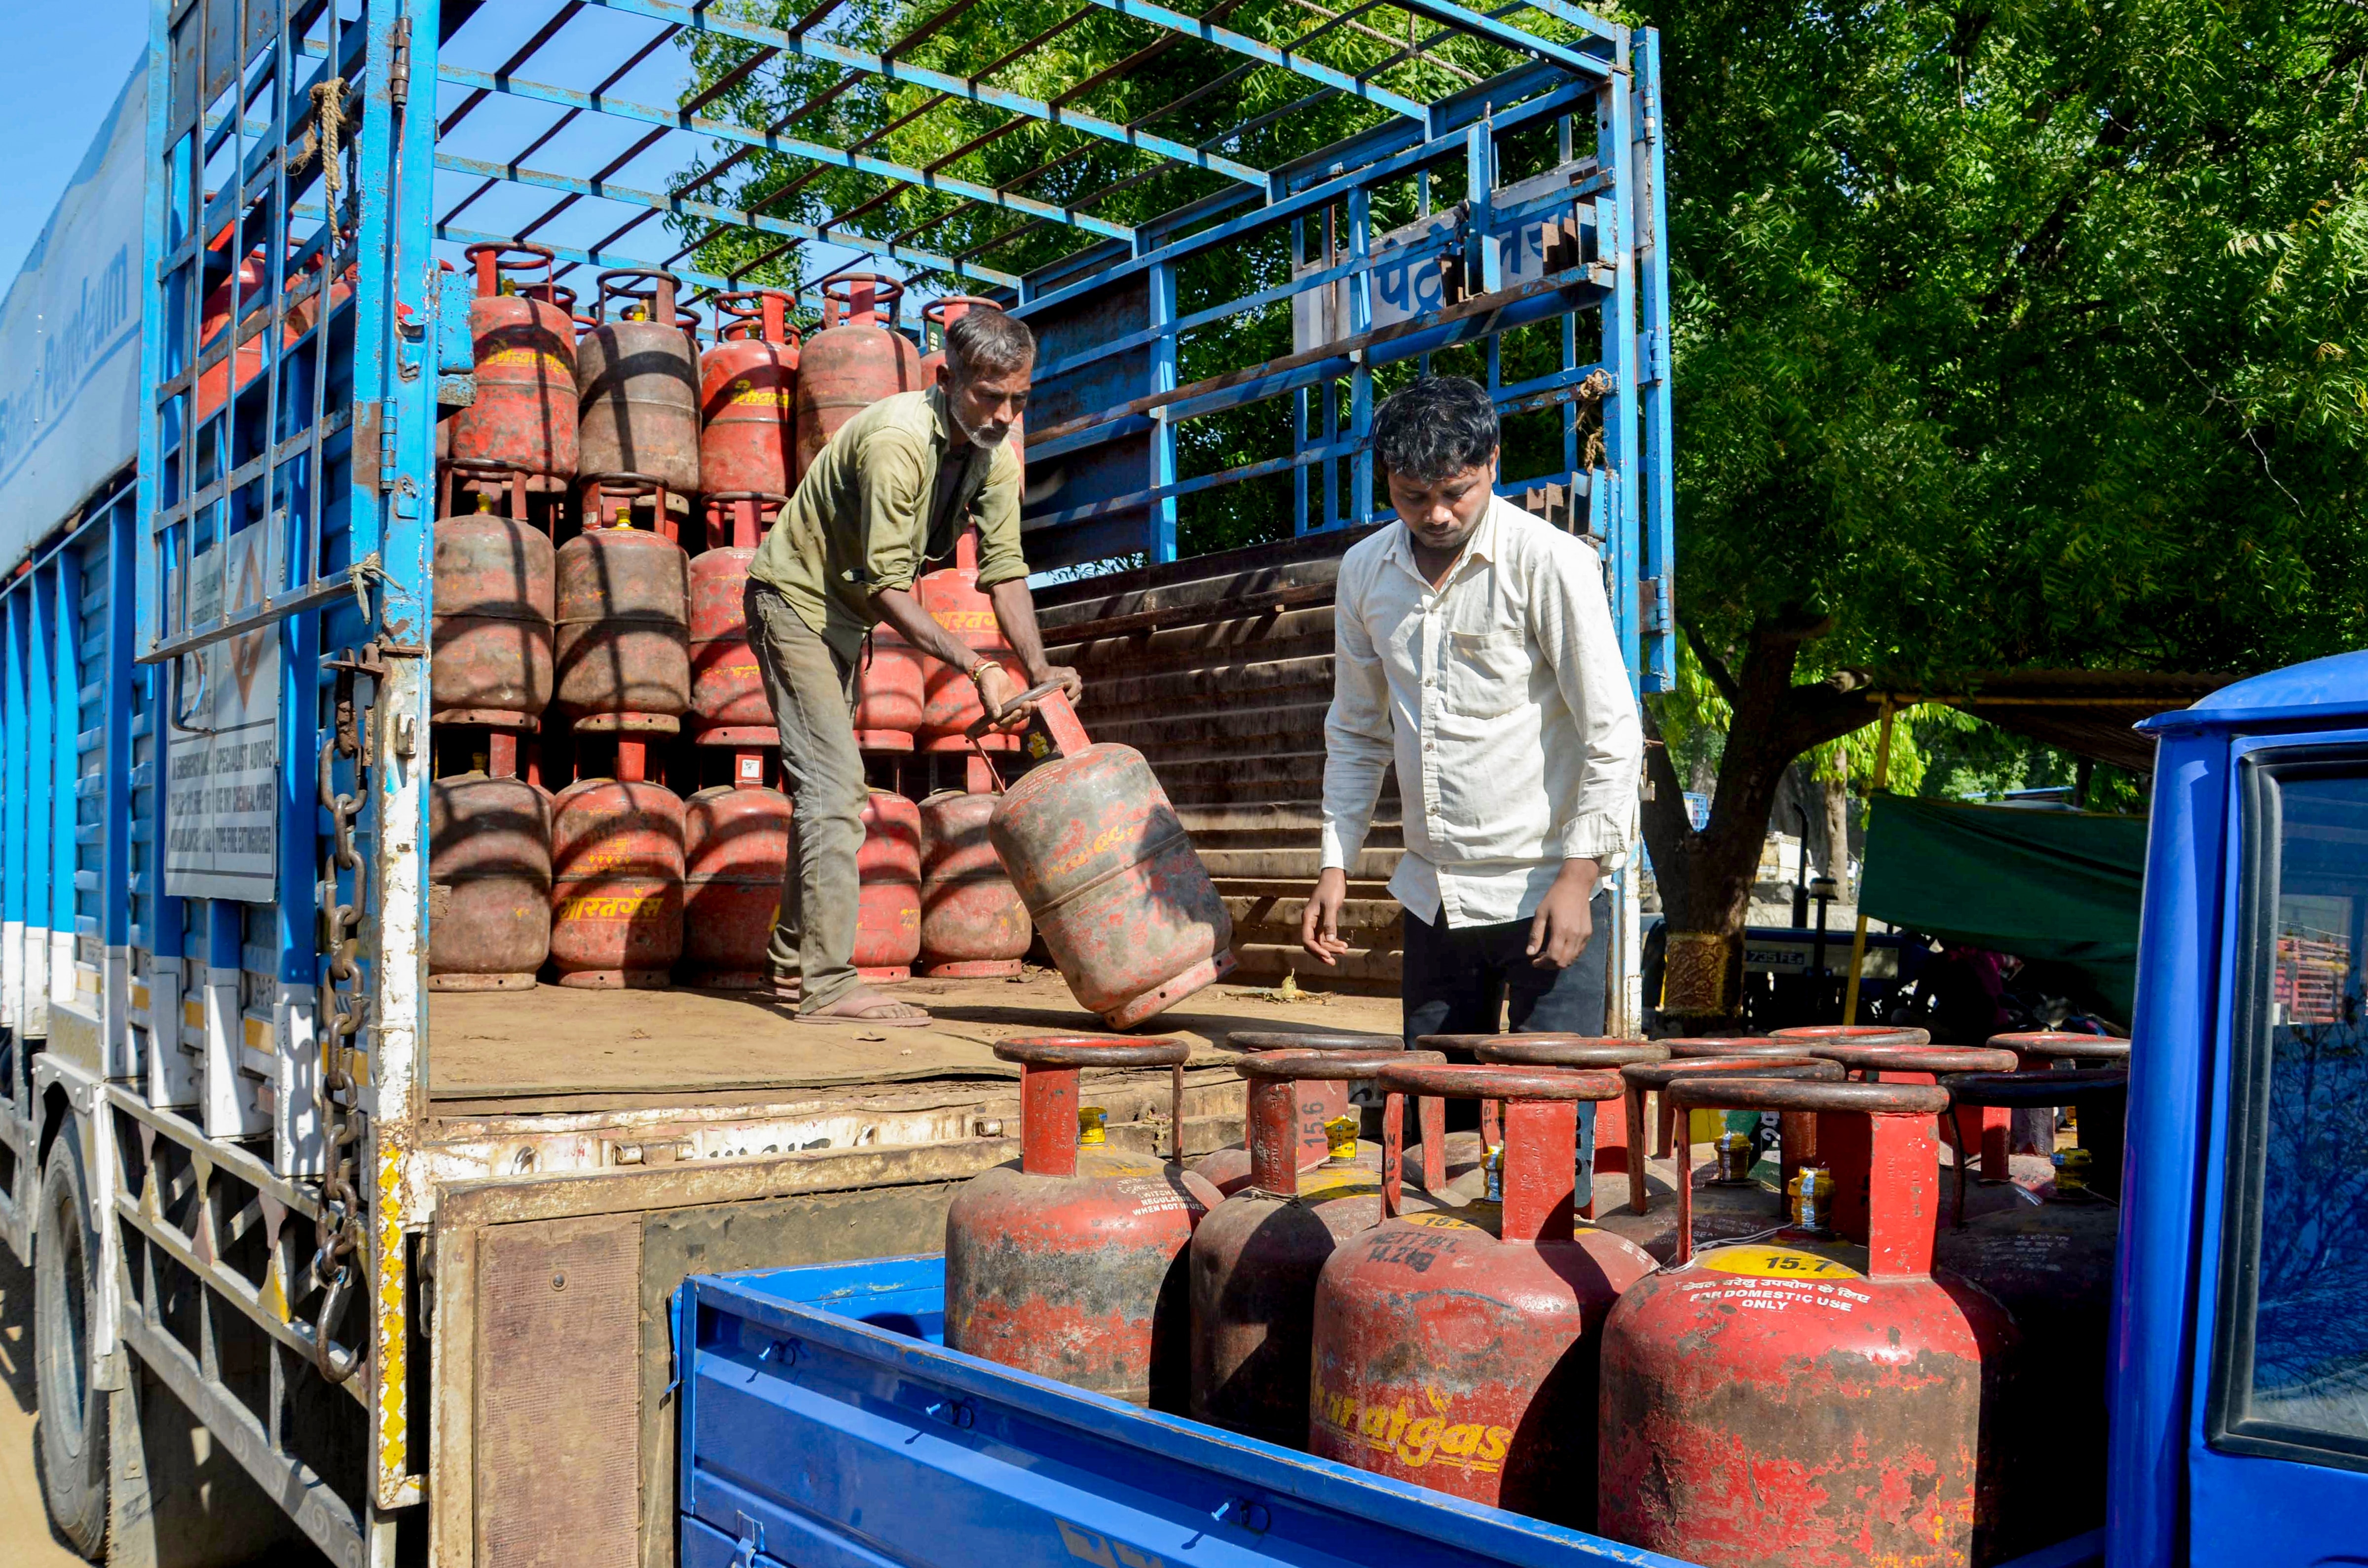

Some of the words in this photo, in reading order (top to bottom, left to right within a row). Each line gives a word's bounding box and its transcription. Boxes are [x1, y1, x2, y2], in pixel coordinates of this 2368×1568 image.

[1750, 951, 1776, 962] 735
[1301, 1101, 1327, 1149] 15.6
[1384, 1133, 1395, 1186] 16.2
[1140, 1196, 1193, 1206] REGULATOR
[1132, 1206, 1160, 1217] WHEN
[1161, 1203, 1179, 1211] NOT
[1765, 1256, 1834, 1273] 15.7
[1760, 1278, 1813, 1290] उपयोग
[1817, 1283, 1835, 1293] के
[1838, 1286, 1872, 1304] लिए
[1724, 1289, 1813, 1304] DOMESTIC
[1817, 1297, 1852, 1313] USE
[1741, 1299, 1788, 1311] ONLY
